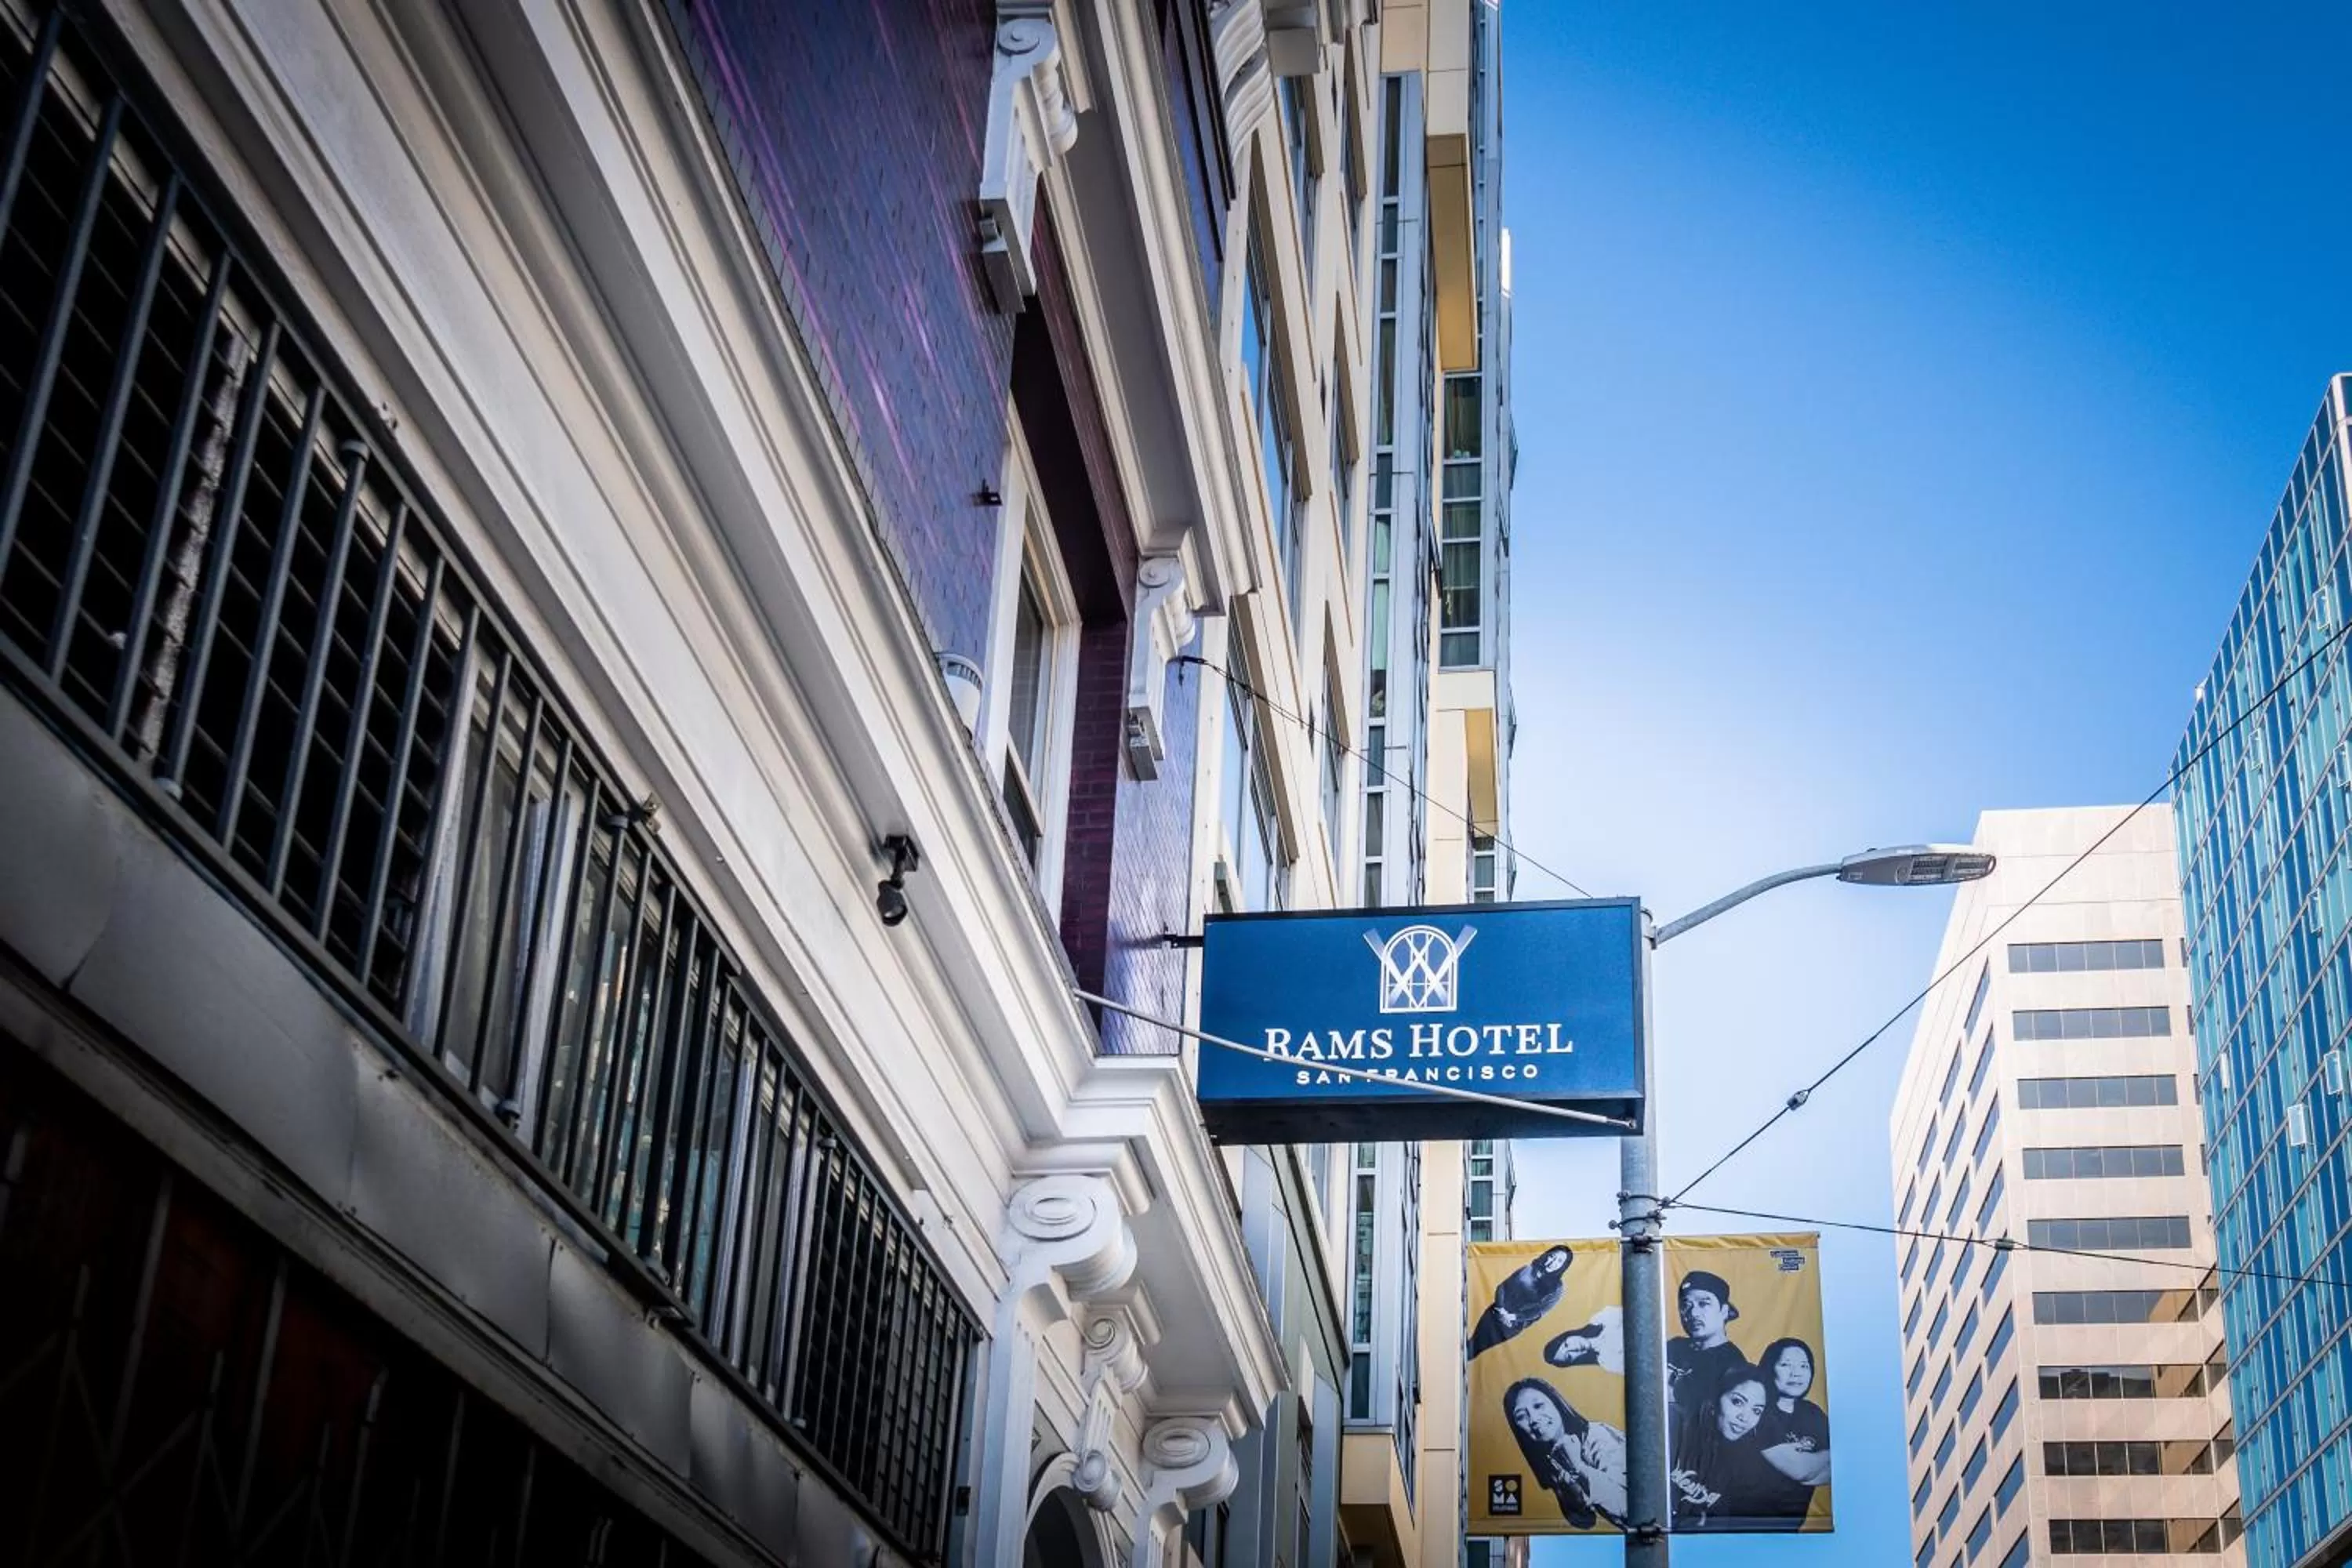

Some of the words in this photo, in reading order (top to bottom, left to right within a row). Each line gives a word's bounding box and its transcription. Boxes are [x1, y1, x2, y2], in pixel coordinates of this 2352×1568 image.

[1264, 1028, 1393, 1062] RAMS
[1409, 1023, 1573, 1057] HOTEL
[1296, 1070, 1352, 1084] SAN
